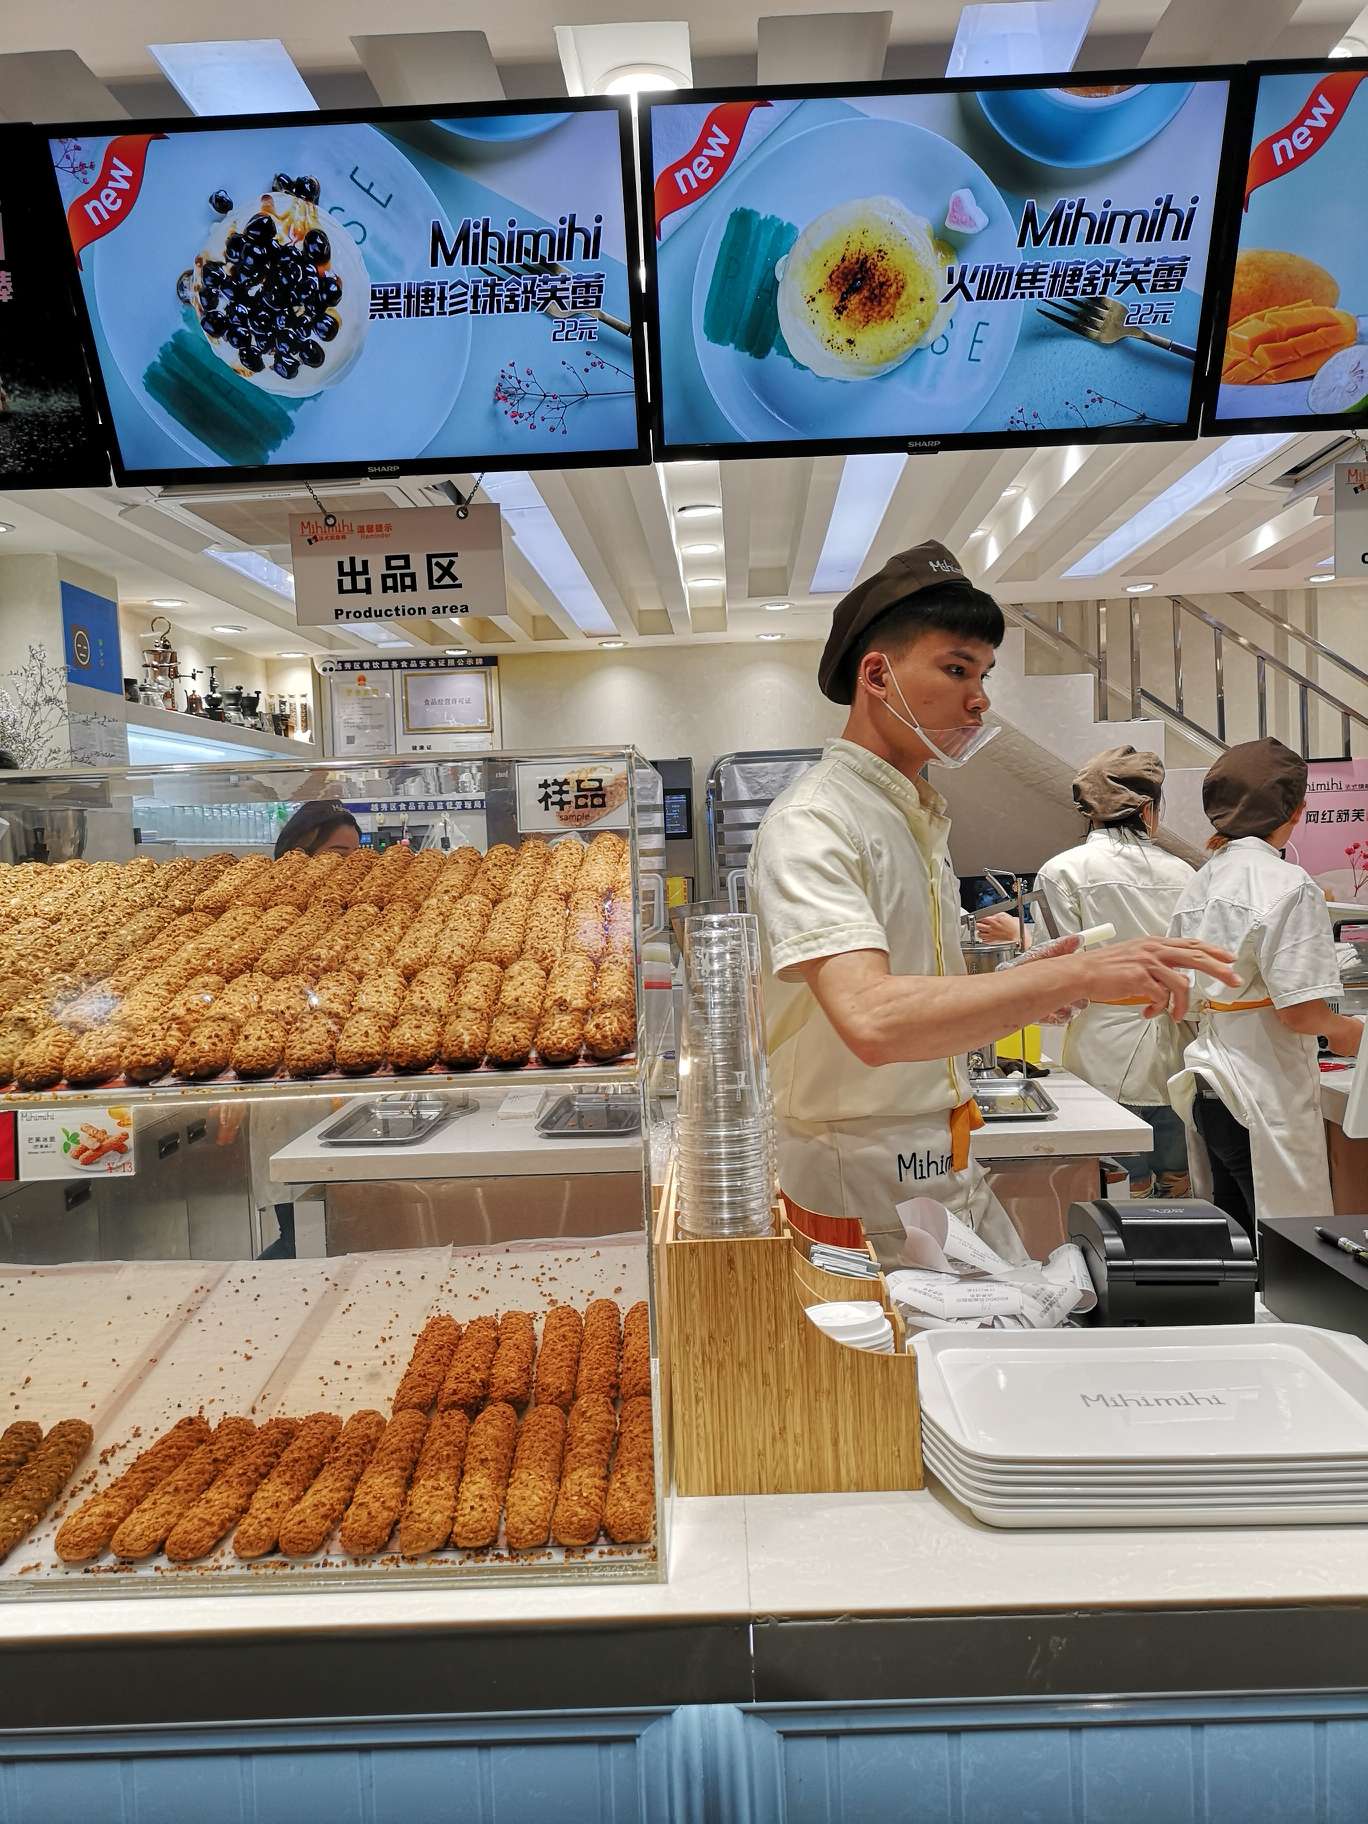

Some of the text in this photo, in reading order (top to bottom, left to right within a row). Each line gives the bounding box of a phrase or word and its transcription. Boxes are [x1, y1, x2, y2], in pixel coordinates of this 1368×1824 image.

[1272, 94, 1335, 166] new
[674, 124, 730, 195] new
[84, 156, 133, 226] new
[1016, 193, 1200, 249] Mihimihi
[430, 212, 603, 268] Mihimihi
[368, 272, 606, 320] 黑糖珍珠舒芙蕾
[940, 255, 1191, 304] 火吻焦糖舒芙蕾
[552, 318, 598, 343] 22元
[1124, 301, 1176, 327] 22元
[907, 440, 941, 448] SHARP
[367, 465, 400, 473] SHARP
[337, 551, 463, 595] 出品区
[334, 603, 469, 620] Production area
[370, 800, 486, 812] 越秀区食品药品监督管理局
[538, 778, 607, 811] 样品
[559, 812, 591, 823] sample
[1080, 1392, 1227, 1408] Mihimihi
